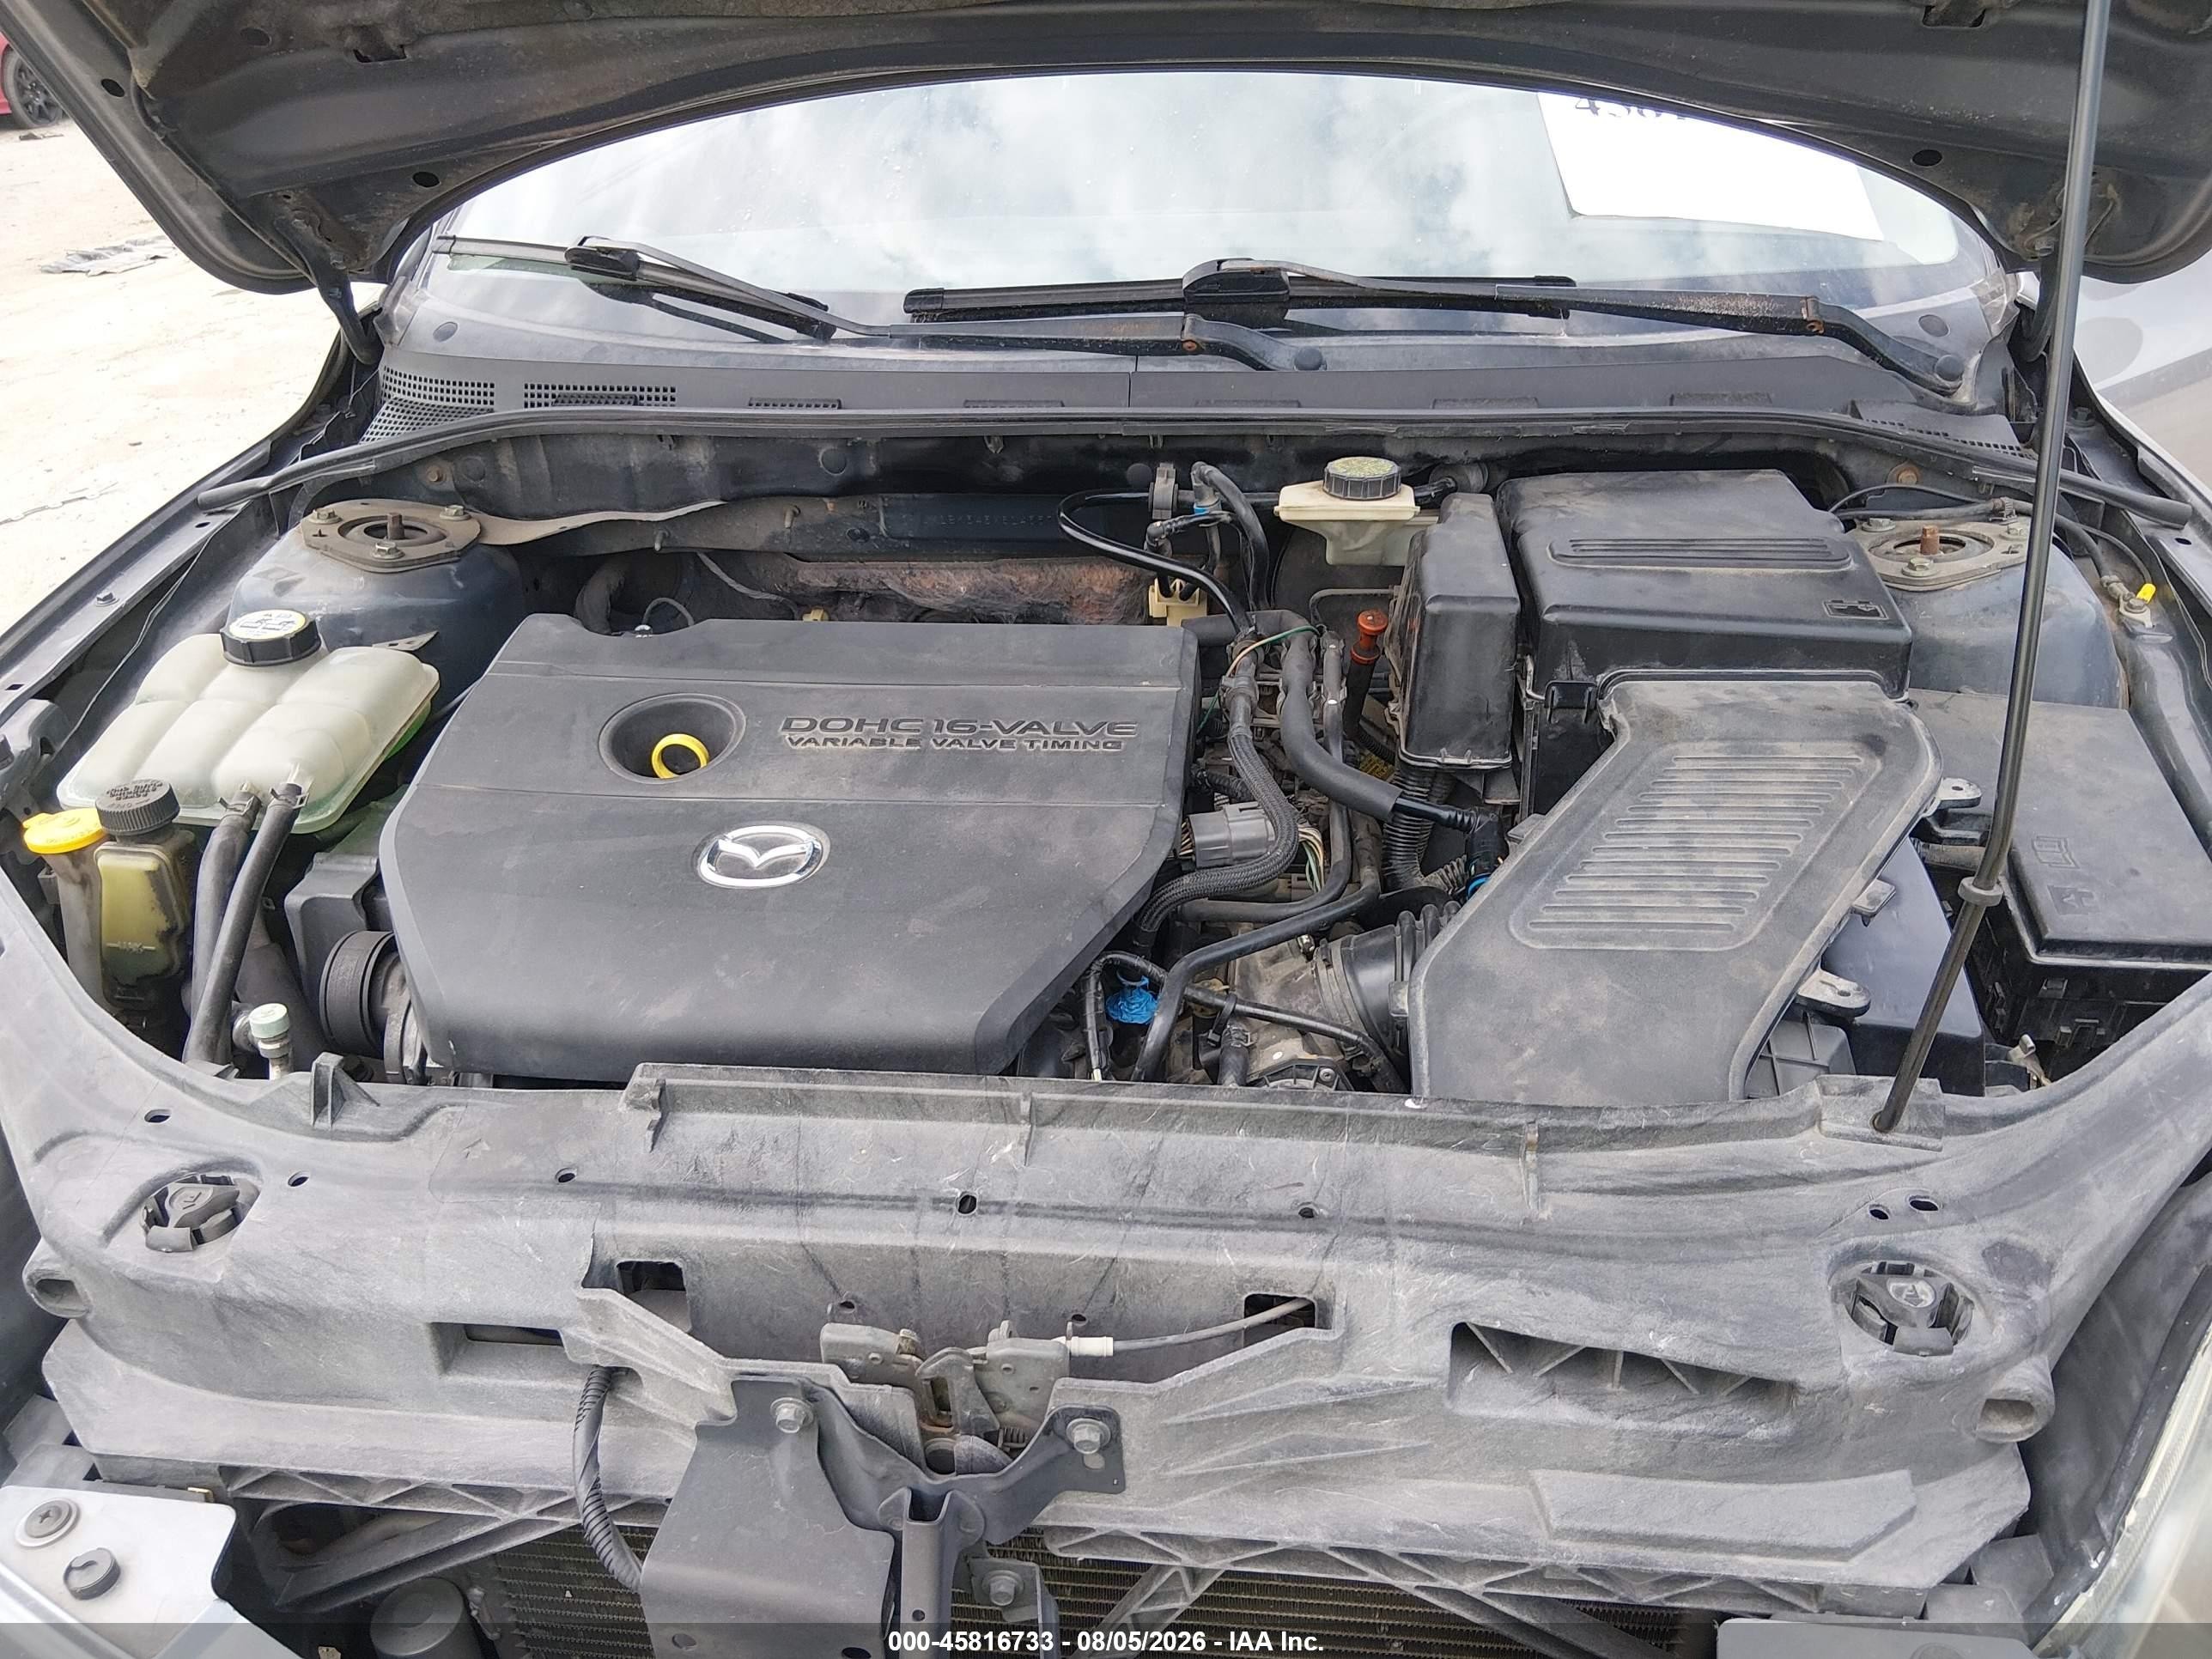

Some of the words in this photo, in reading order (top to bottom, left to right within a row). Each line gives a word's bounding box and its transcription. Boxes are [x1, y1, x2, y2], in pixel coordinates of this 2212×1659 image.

[781, 716, 923, 734] DOHC
[933, 718, 1137, 737] 16-VALVE
[787, 736, 922, 749] VARIABLE
[932, 738, 1017, 750] VALVE
[1026, 739, 1124, 750] TIMING
